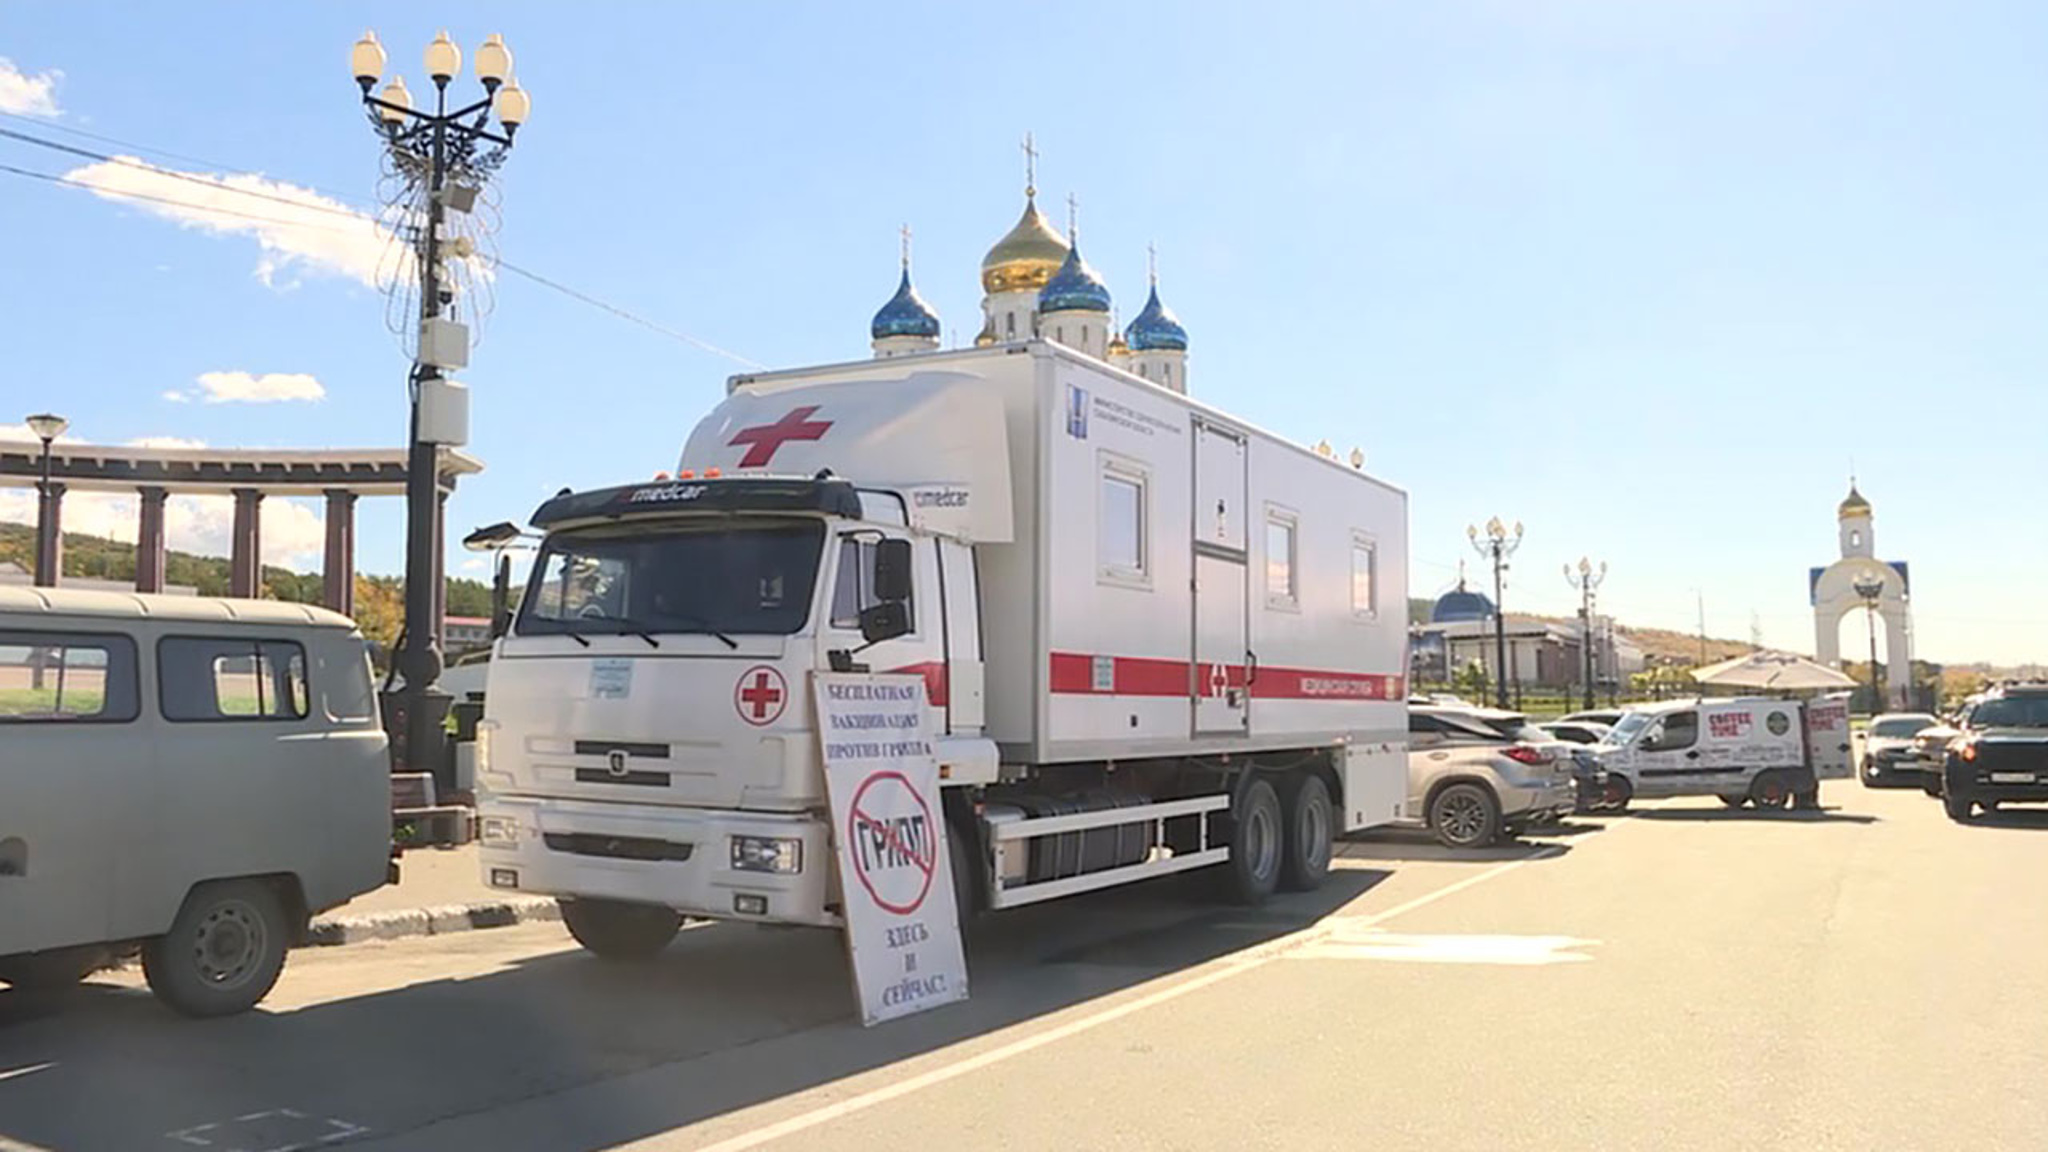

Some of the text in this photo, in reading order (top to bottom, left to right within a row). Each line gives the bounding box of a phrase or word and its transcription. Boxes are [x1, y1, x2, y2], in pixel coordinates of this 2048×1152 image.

[629, 483, 708, 503] medcar
[827, 684, 915, 701] БЕСПЛАТНАЯ
[1708, 711, 1752, 725] COFFEE
[857, 814, 930, 872] ГРИПП
[885, 922, 930, 949] ЗДЕСЬ
[882, 973, 947, 1008] СЕЙЧАС!
